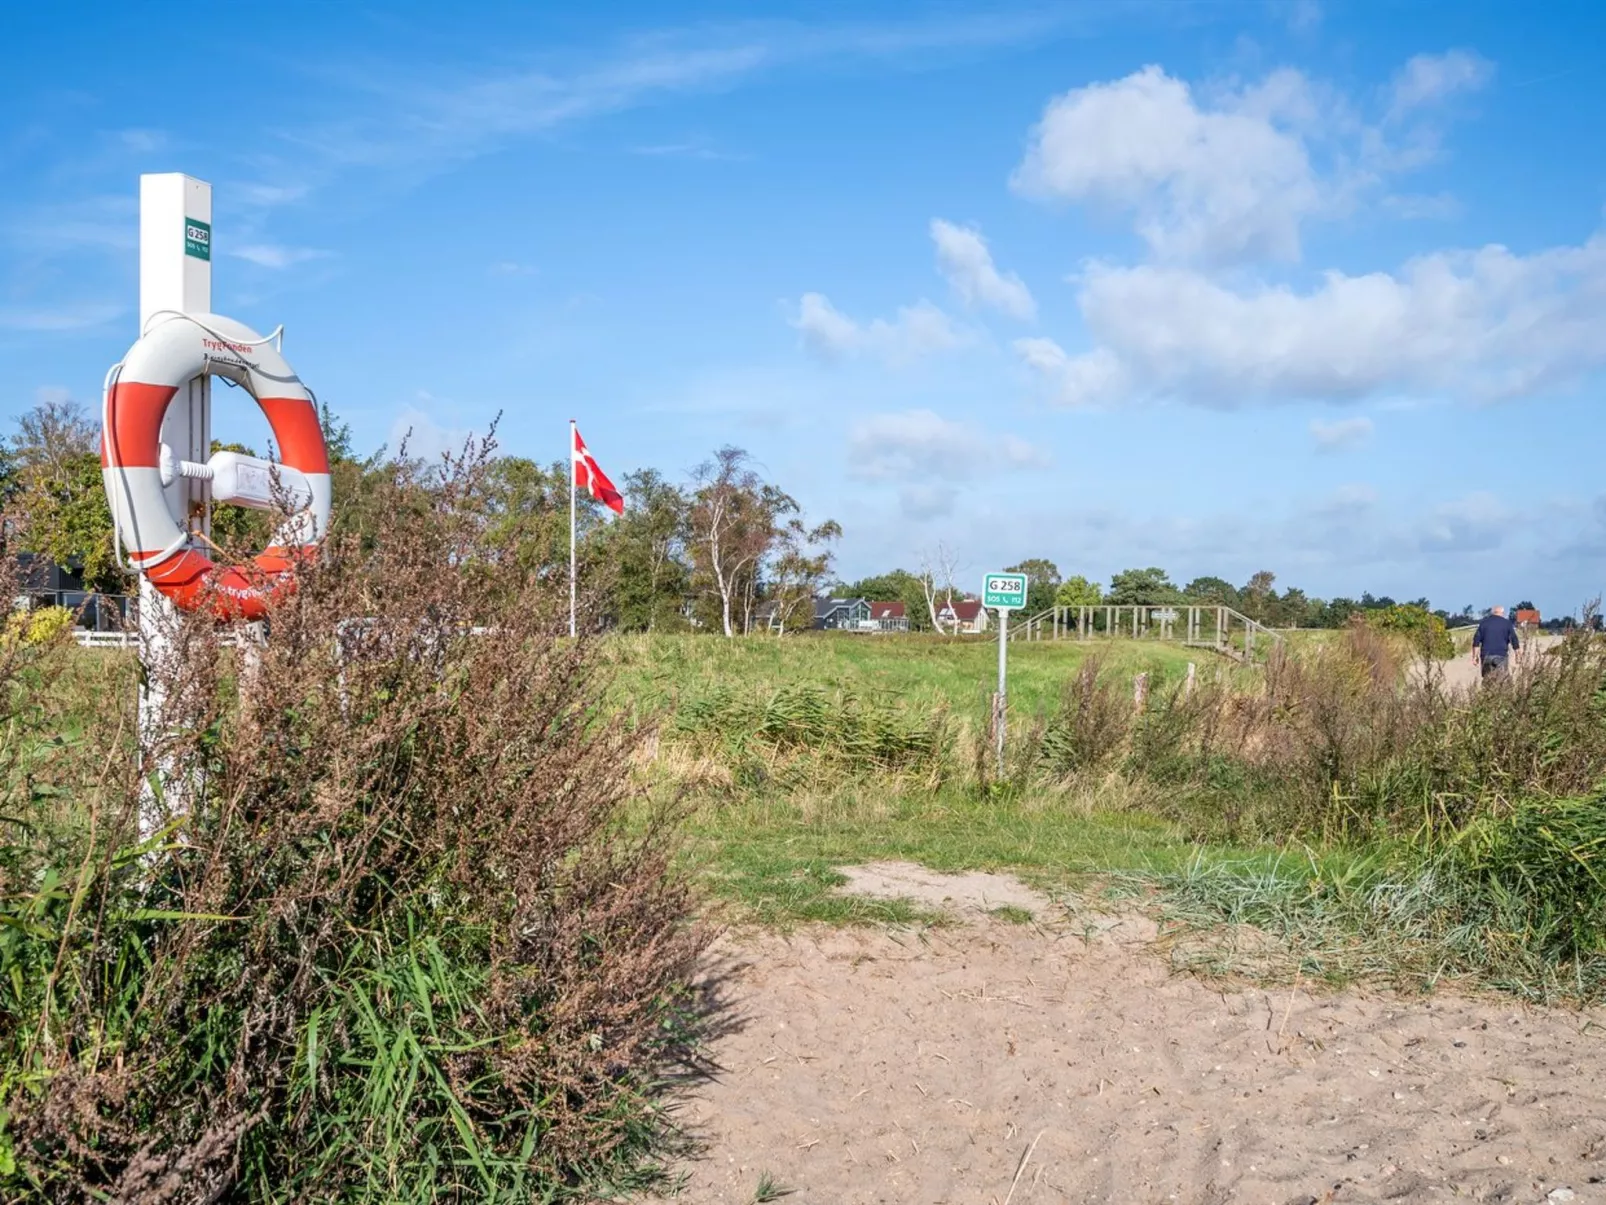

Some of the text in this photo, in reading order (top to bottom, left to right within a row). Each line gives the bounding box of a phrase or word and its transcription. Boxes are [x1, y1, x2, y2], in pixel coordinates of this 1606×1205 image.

[188, 228, 208, 241] G 258
[989, 580, 1021, 591] G 258
